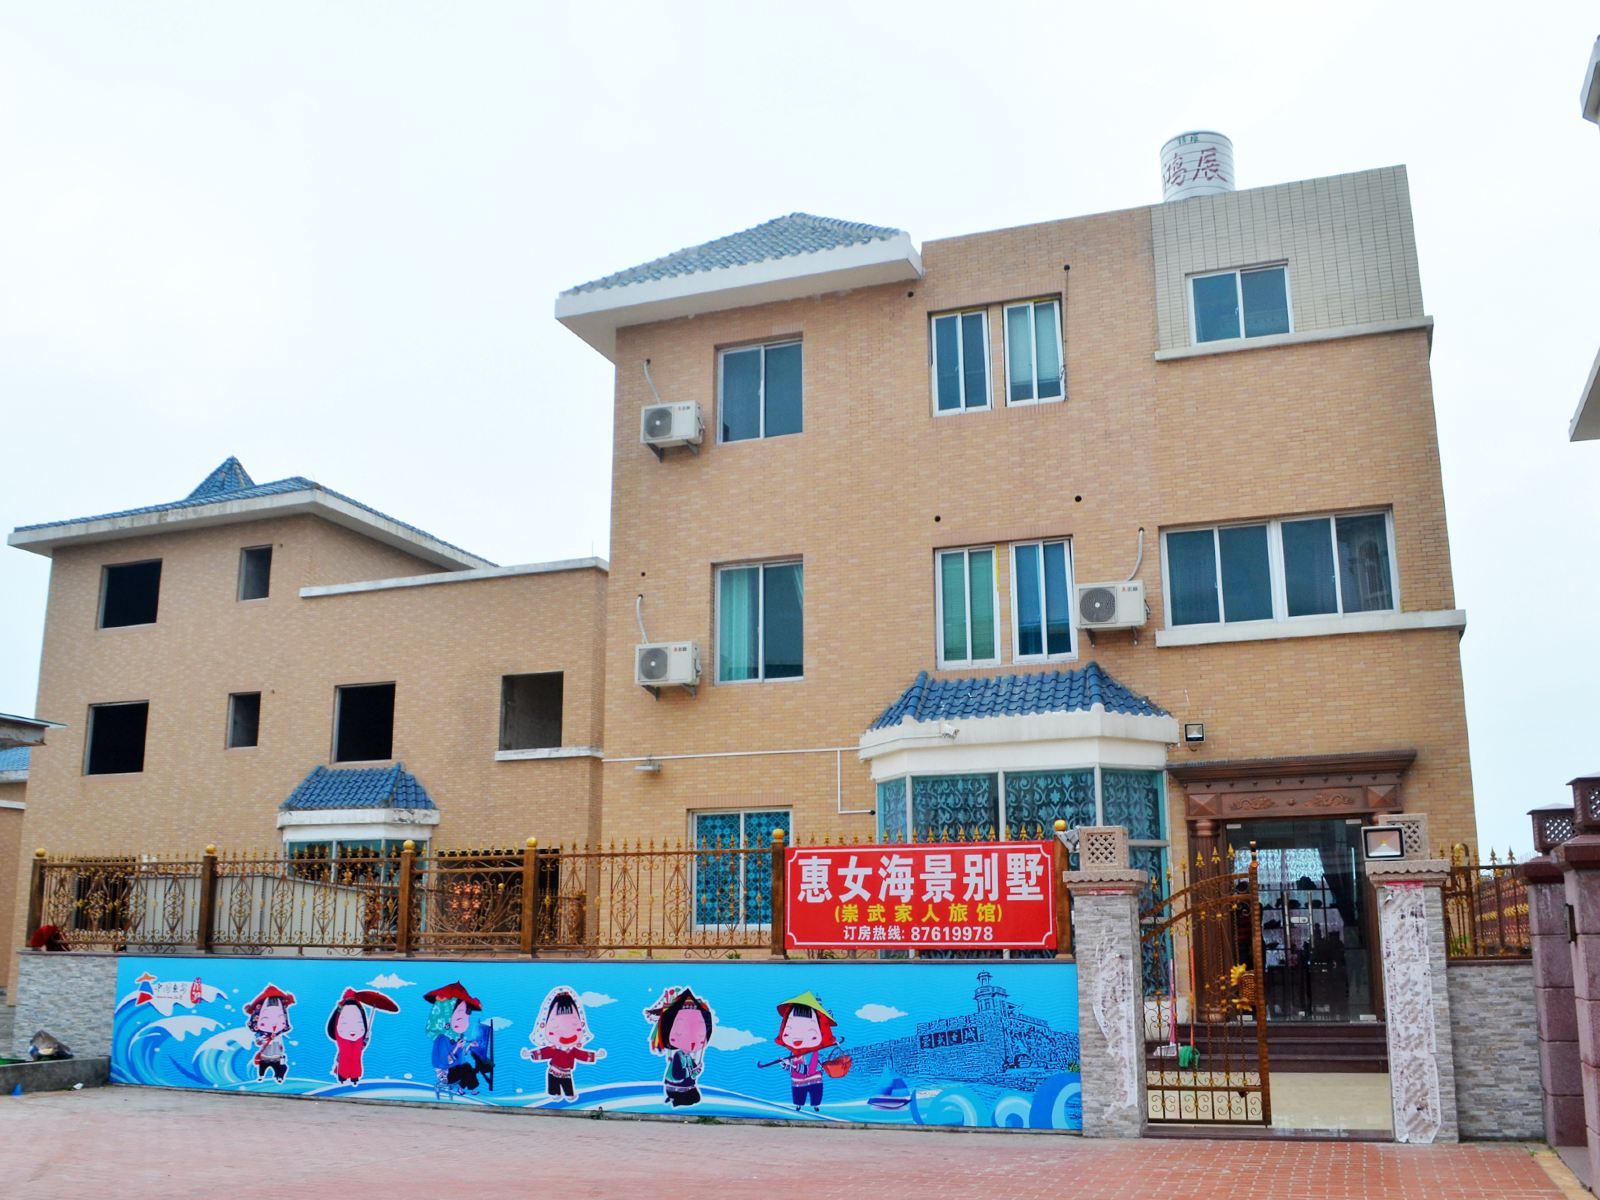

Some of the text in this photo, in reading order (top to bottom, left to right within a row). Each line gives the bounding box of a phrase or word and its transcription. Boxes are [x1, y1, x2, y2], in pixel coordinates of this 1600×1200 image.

[797, 852, 1044, 903] 惠女海景别墅
[834, 903, 1003, 923] (崇武家人旅馆)
[843, 926, 993, 941] 订房热线: 87619978
